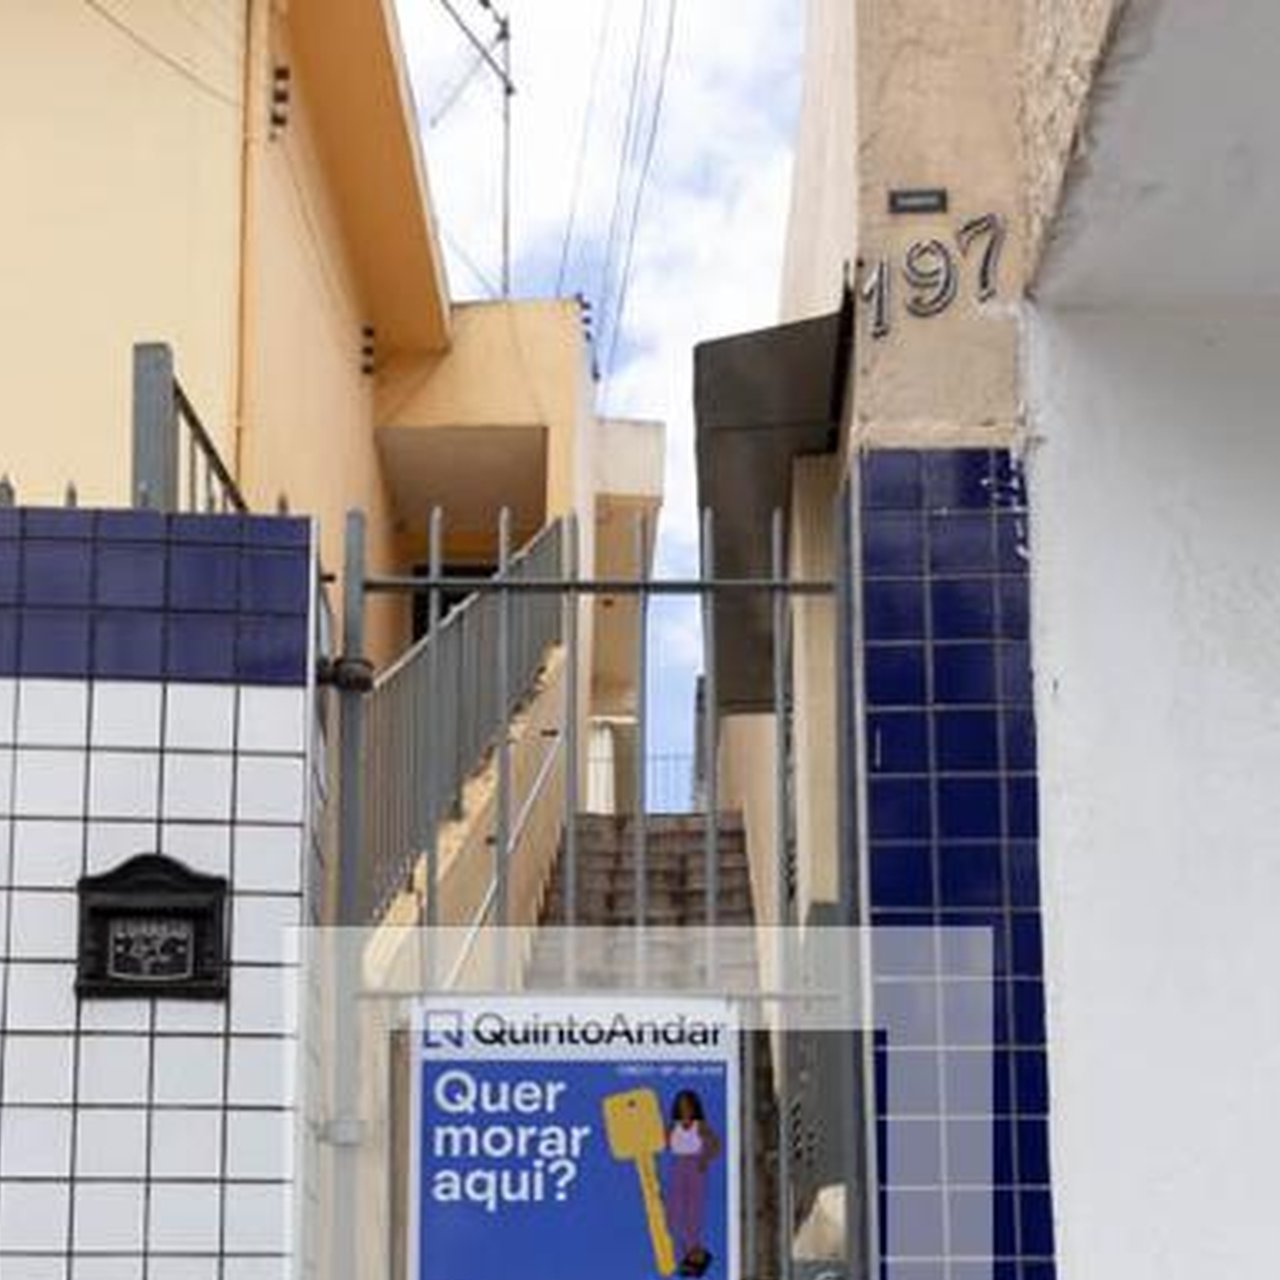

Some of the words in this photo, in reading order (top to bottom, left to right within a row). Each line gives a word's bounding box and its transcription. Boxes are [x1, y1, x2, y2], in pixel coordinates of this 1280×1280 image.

[862, 213, 1007, 339] 197
[473, 1012, 724, 1048] QuintoAndar
[434, 1070, 566, 1114] Quer
[434, 1123, 590, 1157] morar
[432, 1159, 577, 1211] aqui?
